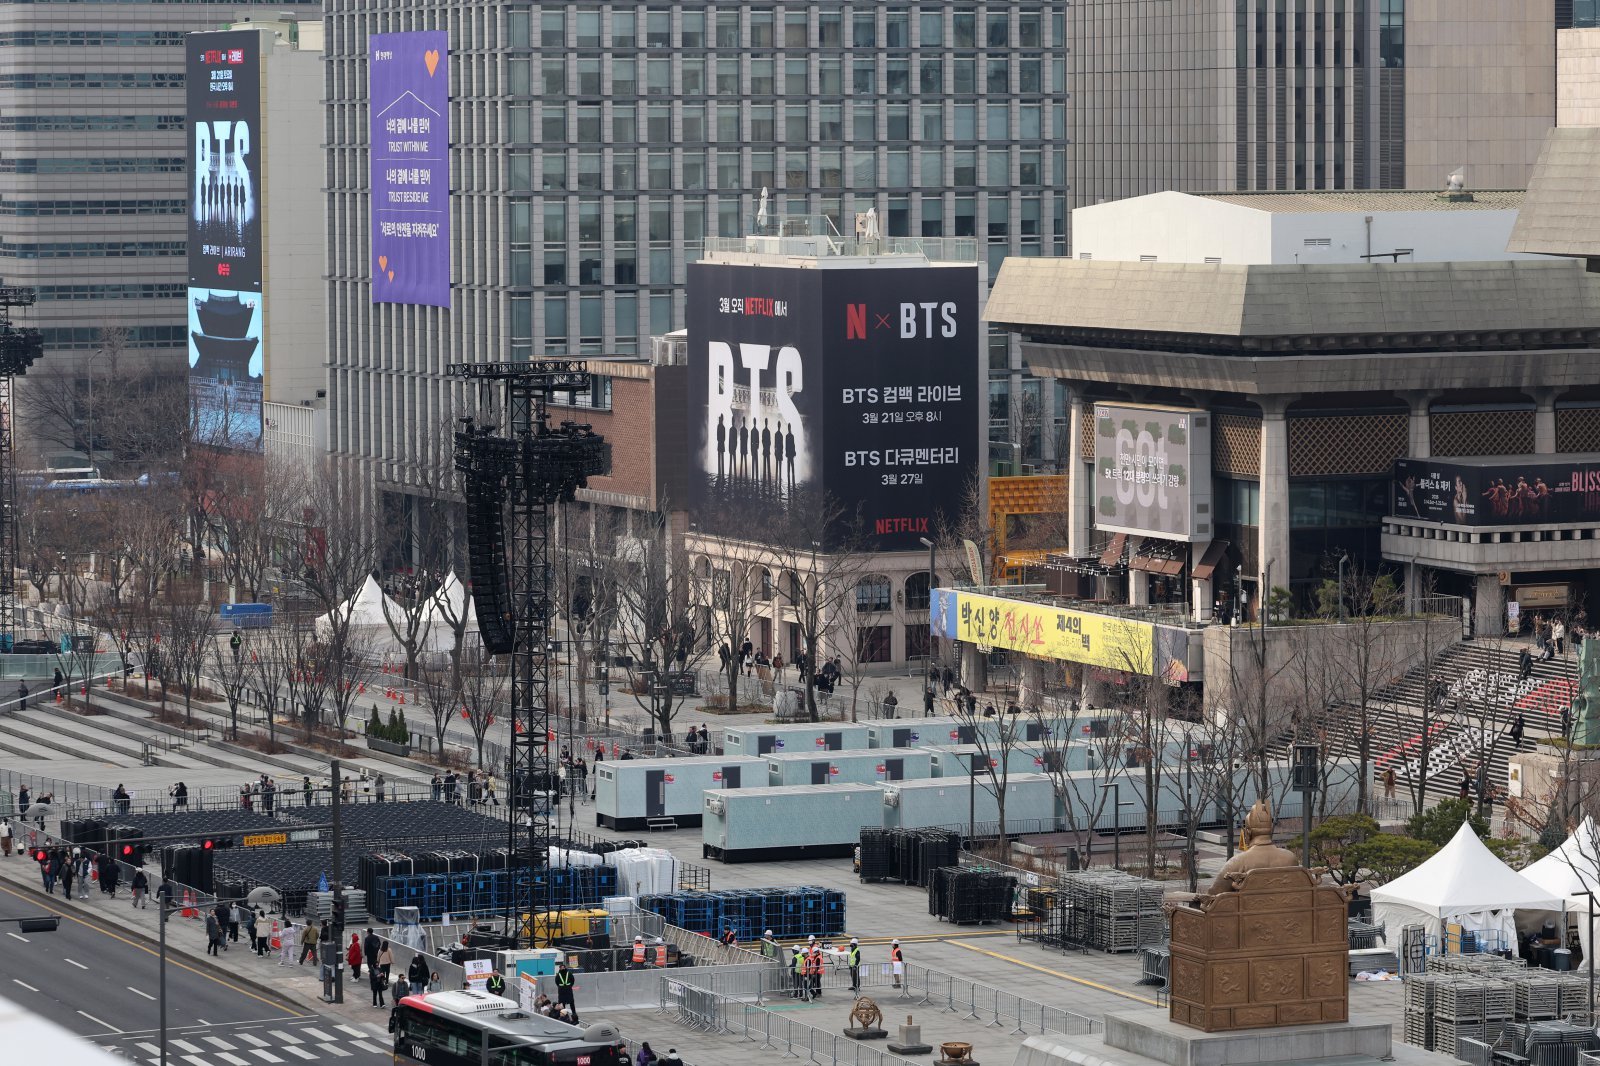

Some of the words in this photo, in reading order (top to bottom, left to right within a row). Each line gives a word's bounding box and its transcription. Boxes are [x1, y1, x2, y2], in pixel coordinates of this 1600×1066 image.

[388, 141, 403, 152] TRUST
[403, 141, 420, 152] WITHIN
[420, 141, 429, 152] ME
[195, 120, 251, 219] BTS
[388, 191, 403, 202] TRUST
[403, 191, 421, 202] BESIDE
[421, 191, 429, 202] ME
[719, 297, 730, 313] 3월
[731, 298, 744, 314] 오직
[846, 303, 867, 340] N
[900, 301, 957, 339] BTS
[842, 387, 879, 404] BTS
[883, 386, 913, 404] 컴백
[917, 385, 962, 403] 라이브
[707, 341, 804, 492] BTS
[862, 412, 879, 424] 3월
[881, 412, 904, 424] 21일
[906, 411, 924, 422] 오후
[926, 411, 942, 422] 8시
[844, 450, 881, 466] BTS
[885, 447, 959, 466] 다큐멘터리
[881, 473, 898, 485] 3월
[900, 473, 923, 485] 27일
[875, 517, 929, 535] NETFLIX
[1056, 614, 1082, 636] 제4의
[411, 1044, 426, 1061] 1000
[577, 1056, 591, 1065] 1000
